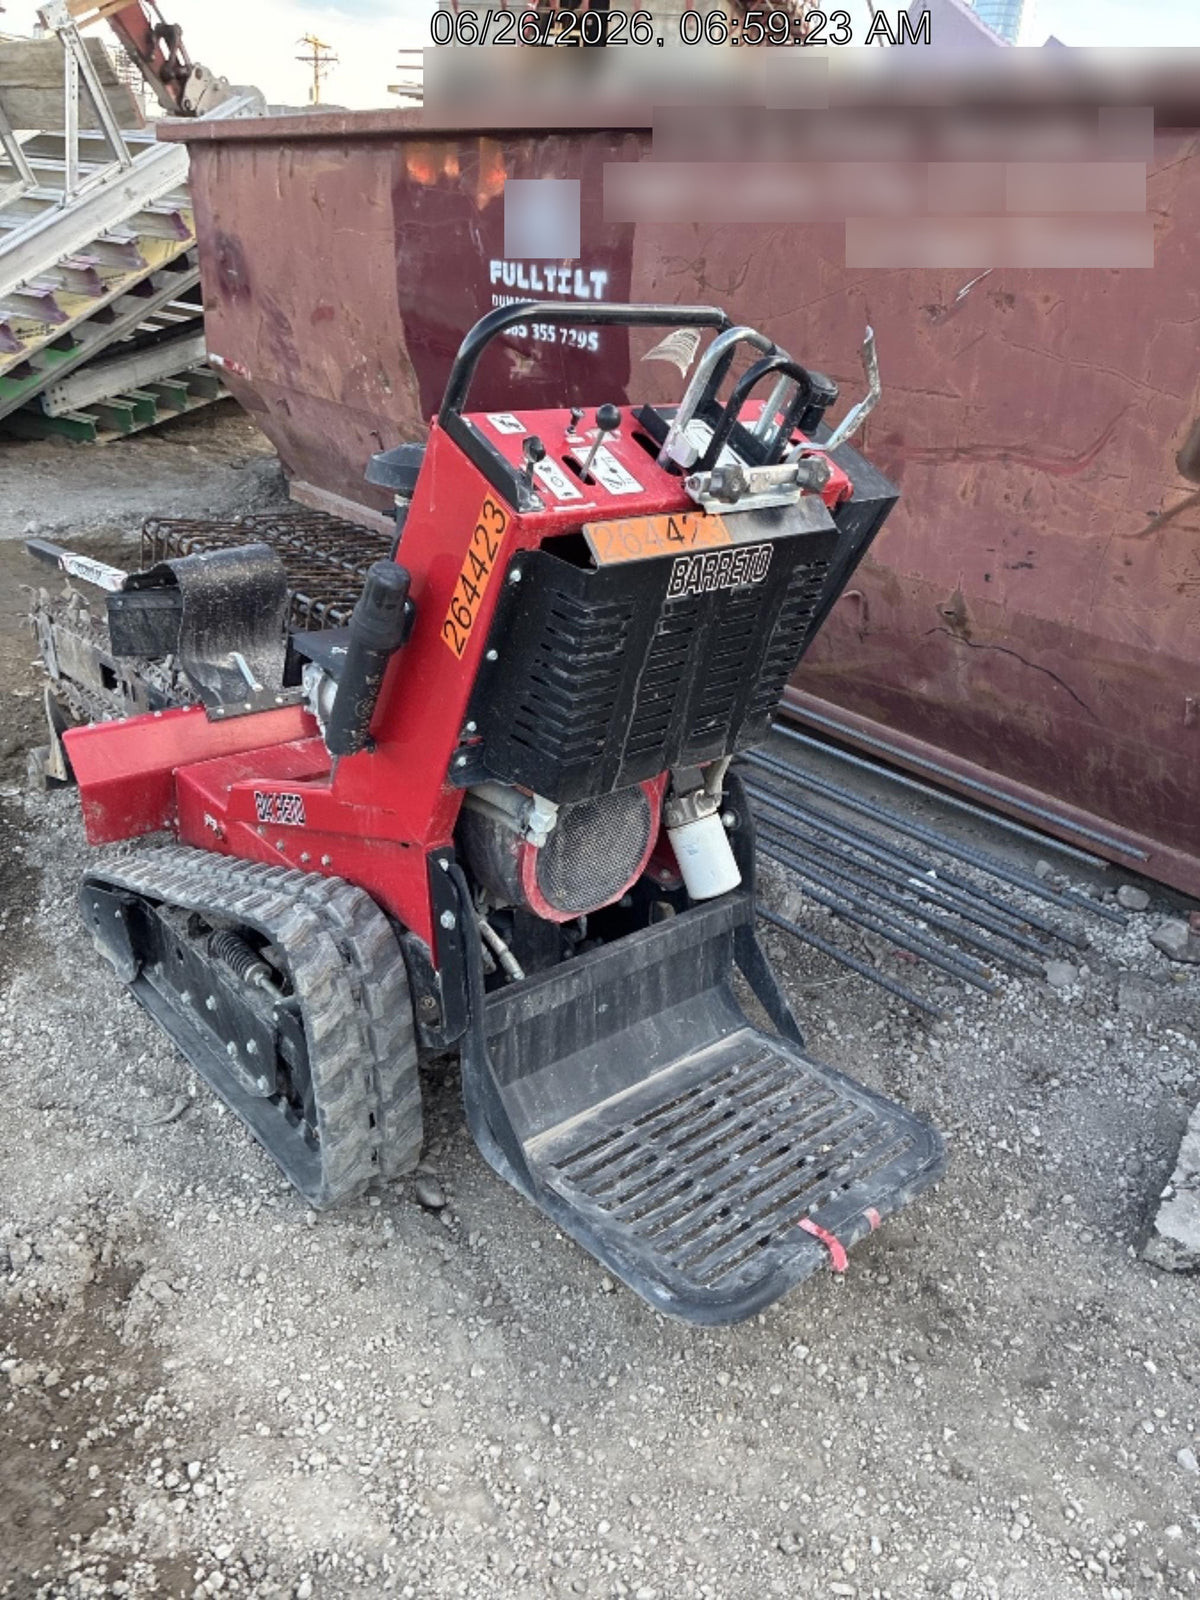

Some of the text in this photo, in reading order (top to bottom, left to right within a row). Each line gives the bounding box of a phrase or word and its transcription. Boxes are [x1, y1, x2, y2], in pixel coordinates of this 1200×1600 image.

[531, 322, 556, 343] 355
[559, 327, 599, 351] 7295
[443, 499, 506, 655] 264423
[666, 543, 774, 599] BARRETO
